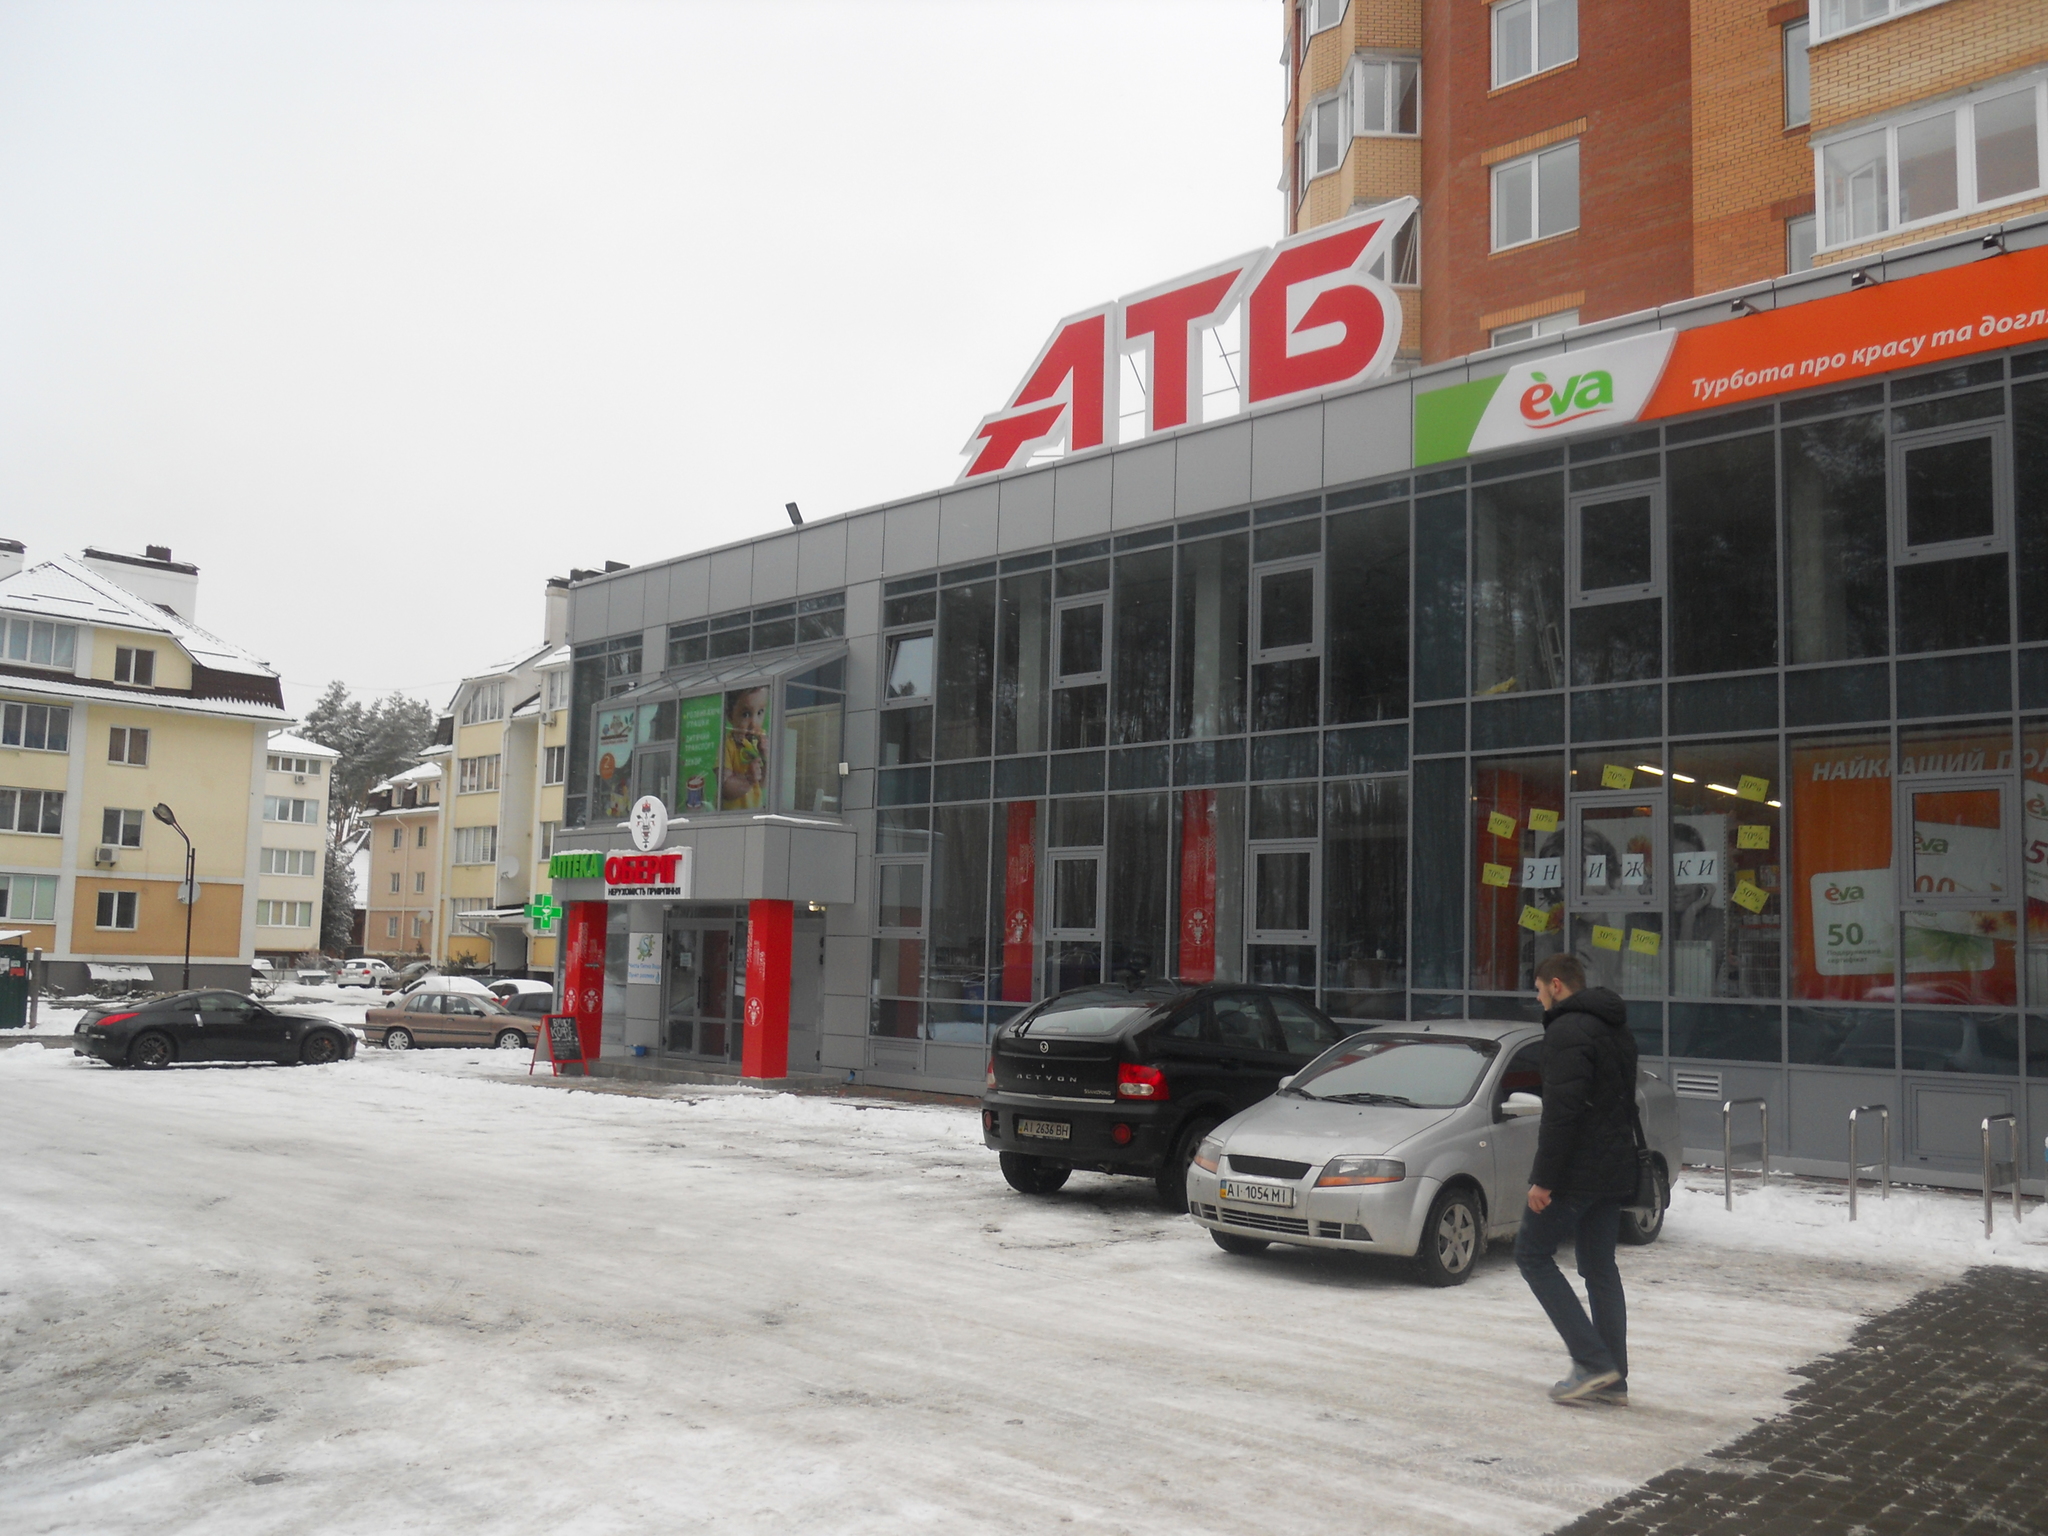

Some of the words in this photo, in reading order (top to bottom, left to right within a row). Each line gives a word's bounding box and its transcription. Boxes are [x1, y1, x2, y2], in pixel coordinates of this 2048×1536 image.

[958, 203, 1408, 482] АТБ
[1692, 361, 1794, 401] Турбота
[1800, 353, 1846, 377] про
[1852, 334, 1926, 367] красу
[1931, 324, 1972, 348] та
[1978, 308, 2048, 338] догл
[1607, 771, 1626, 782] 70%
[1743, 831, 1764, 842] 70%
[548, 852, 602, 878] АПТЕКА
[1740, 886, 1760, 903] 50%
[1827, 922, 1864, 946] 50
[1016, 1073, 1077, 1083] ACTYON
[1023, 1121, 1033, 1133] AI
[1035, 1122, 1054, 1135] 2636
[1056, 1124, 1068, 1137] BH
[1245, 1185, 1269, 1201] 1054
[1271, 1188, 1286, 1203] MI
